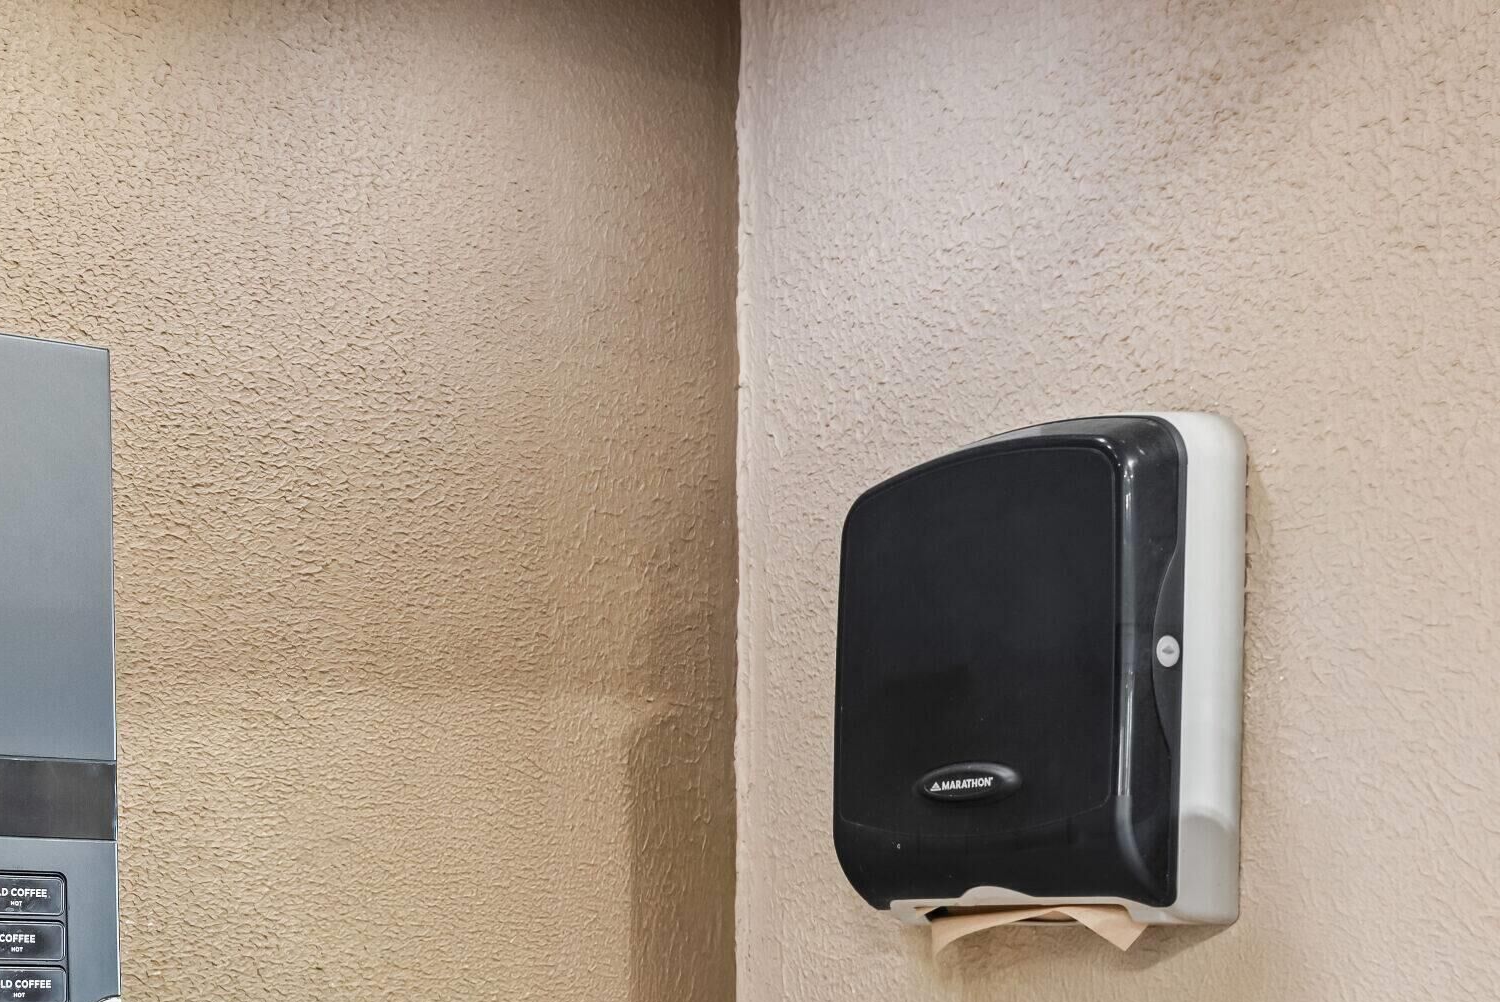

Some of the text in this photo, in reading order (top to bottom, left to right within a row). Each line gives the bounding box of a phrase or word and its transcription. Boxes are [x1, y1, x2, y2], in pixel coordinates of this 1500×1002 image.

[941, 777, 993, 791] MARATHON
[10, 887, 48, 898] COFFEE
[15, 979, 52, 989] COFFEE
